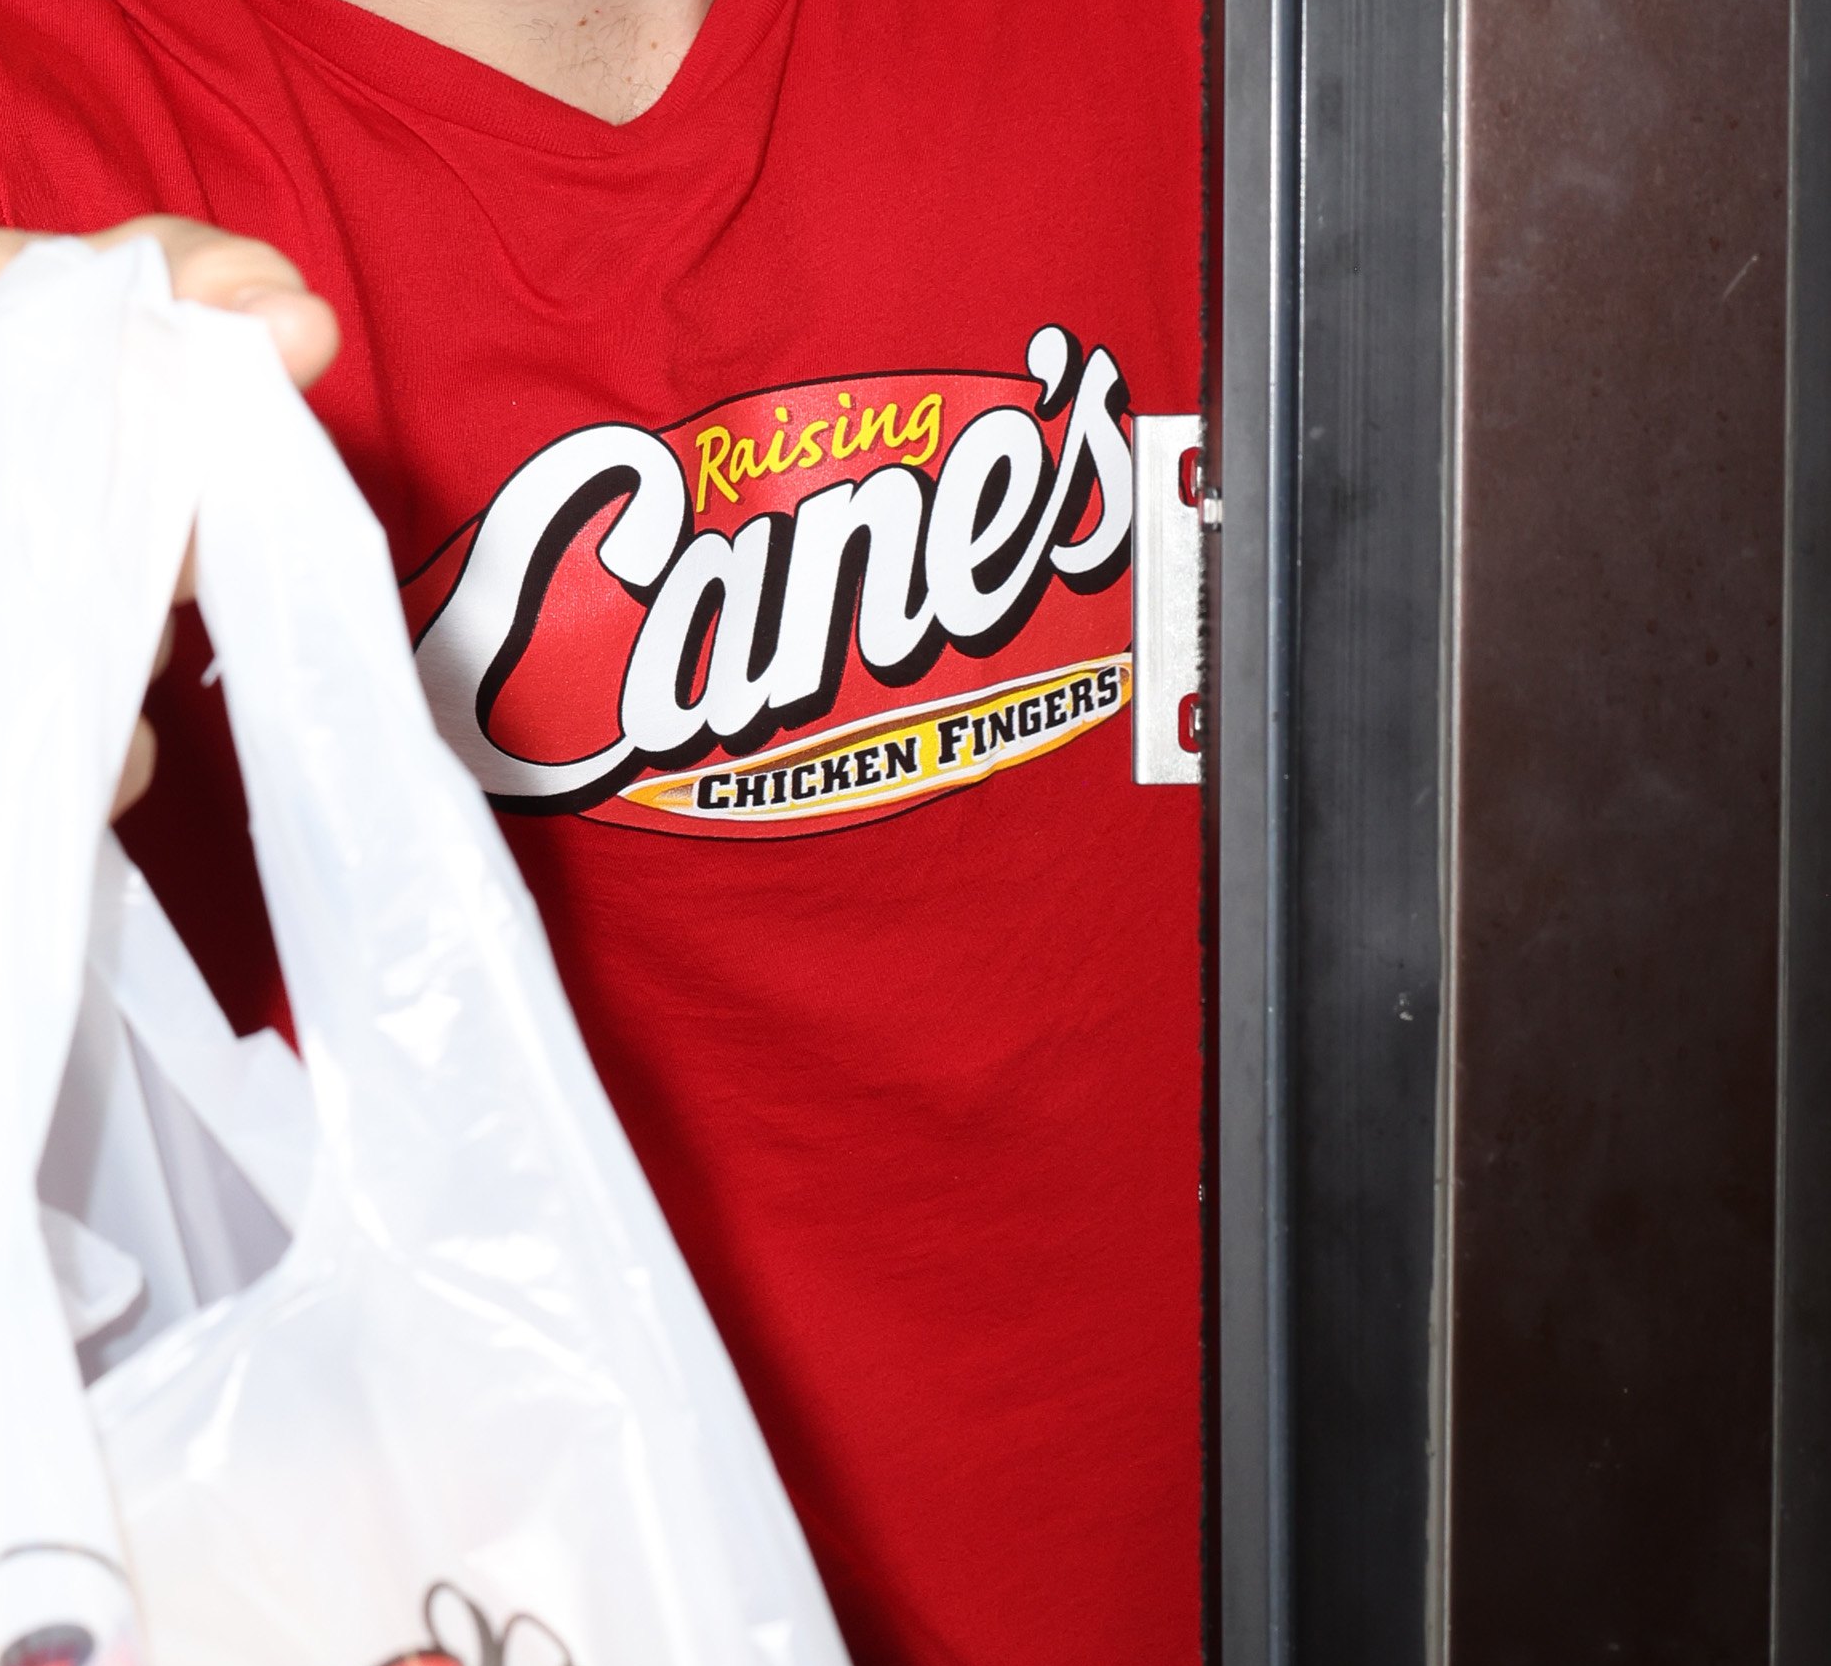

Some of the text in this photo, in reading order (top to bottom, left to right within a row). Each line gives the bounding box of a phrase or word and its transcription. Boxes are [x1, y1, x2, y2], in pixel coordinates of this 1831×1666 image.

[694, 392, 944, 514] Raising
[415, 324, 1134, 814] Cane's
[696, 665, 1121, 811] CHICKEN FINGERS
